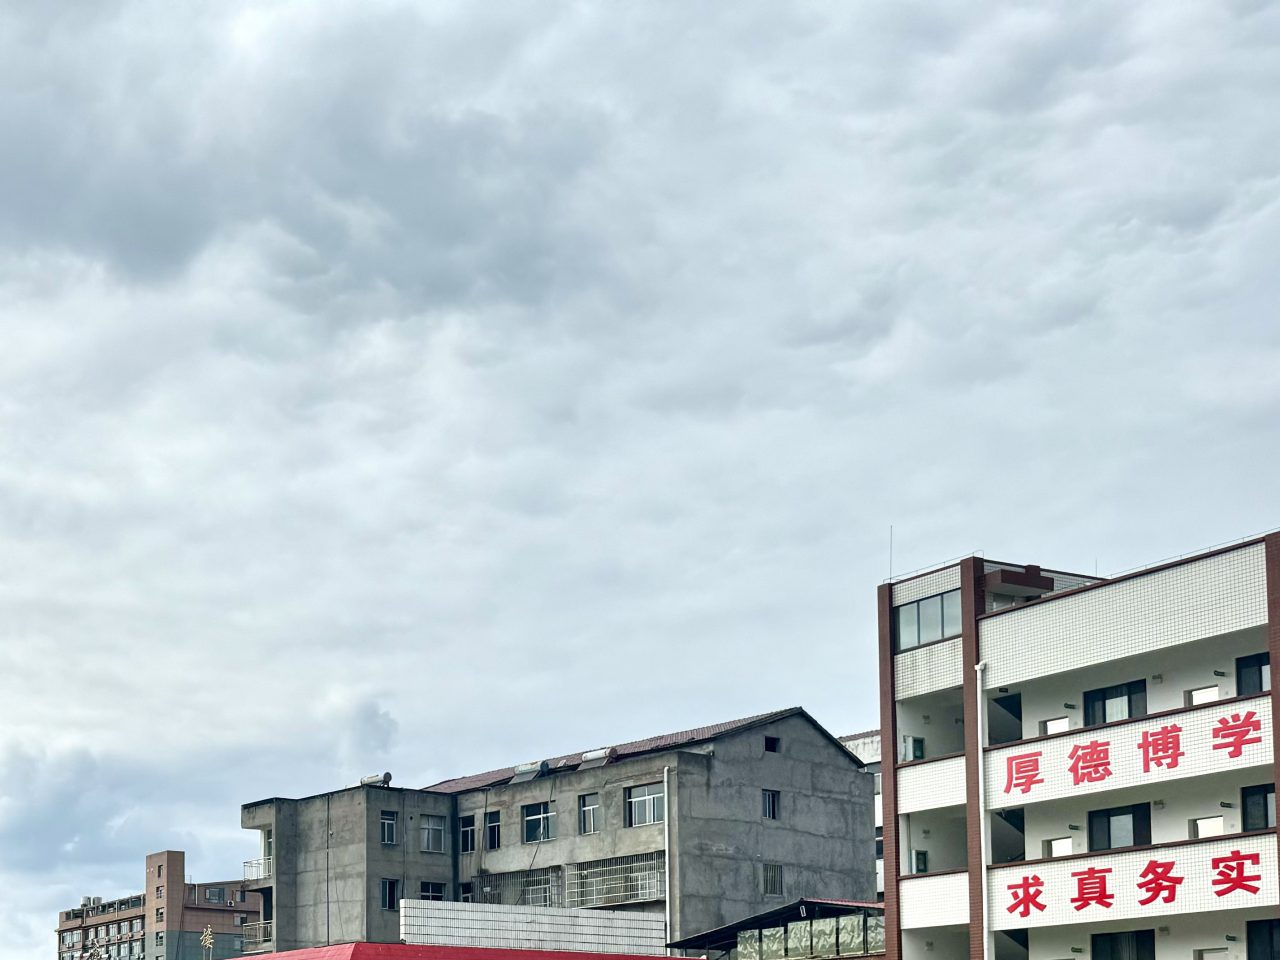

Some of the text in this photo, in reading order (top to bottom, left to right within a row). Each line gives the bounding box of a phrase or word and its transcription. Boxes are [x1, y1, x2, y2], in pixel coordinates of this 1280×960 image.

[1003, 711, 1263, 794] 厚德博学
[1006, 850, 1262, 917] 求真务实
